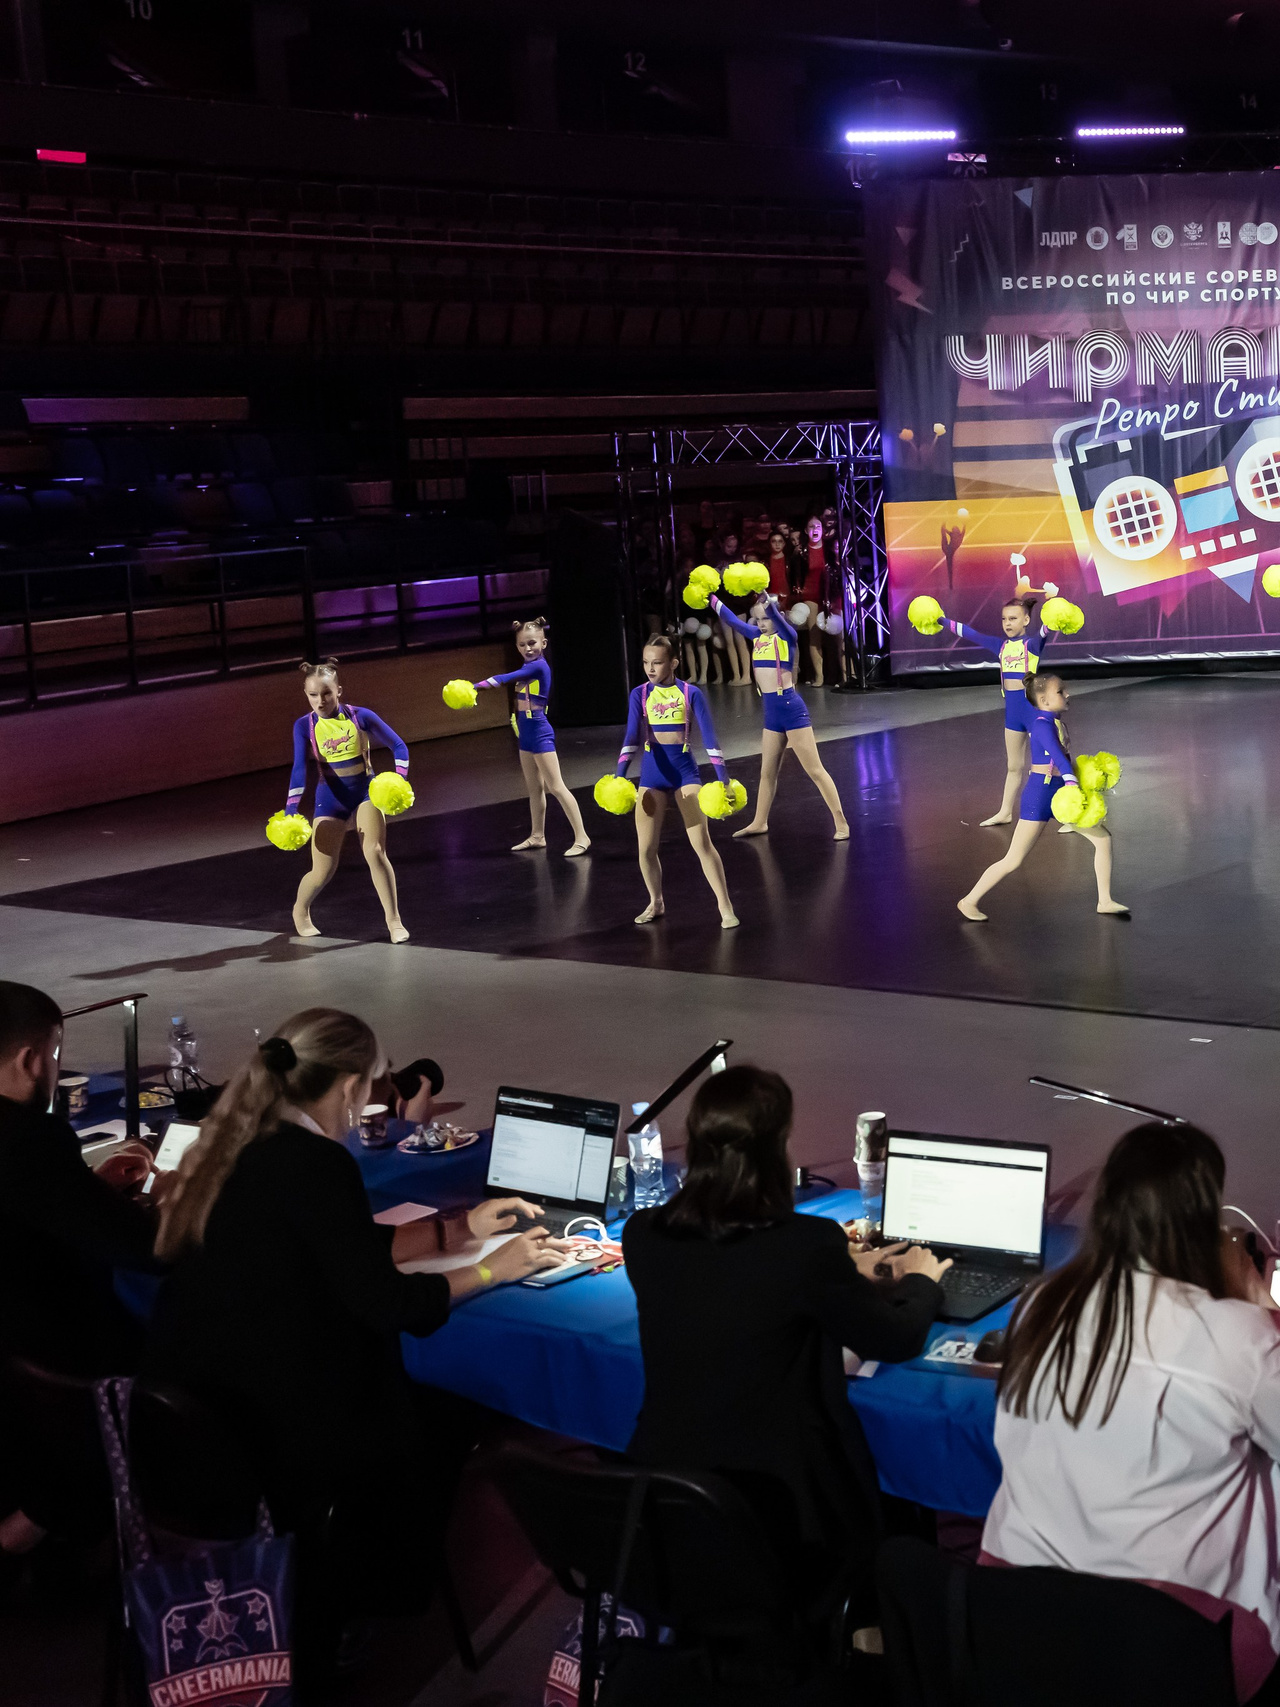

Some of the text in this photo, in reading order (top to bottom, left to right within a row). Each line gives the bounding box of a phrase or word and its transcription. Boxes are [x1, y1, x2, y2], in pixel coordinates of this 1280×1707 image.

[124, 0, 153, 20] 10
[401, 27, 423, 50] 11
[625, 51, 647, 72] 12
[1040, 231, 1078, 247] ЛДПР
[1001, 270, 1196, 290] ВСЕРОССИЙСКИЕ
[1106, 291, 1136, 305] ПО
[1146, 289, 1190, 304] ЧИР
[1094, 398, 1200, 440] Ретро
[153, 1656, 291, 1707] CHEERMANIA
